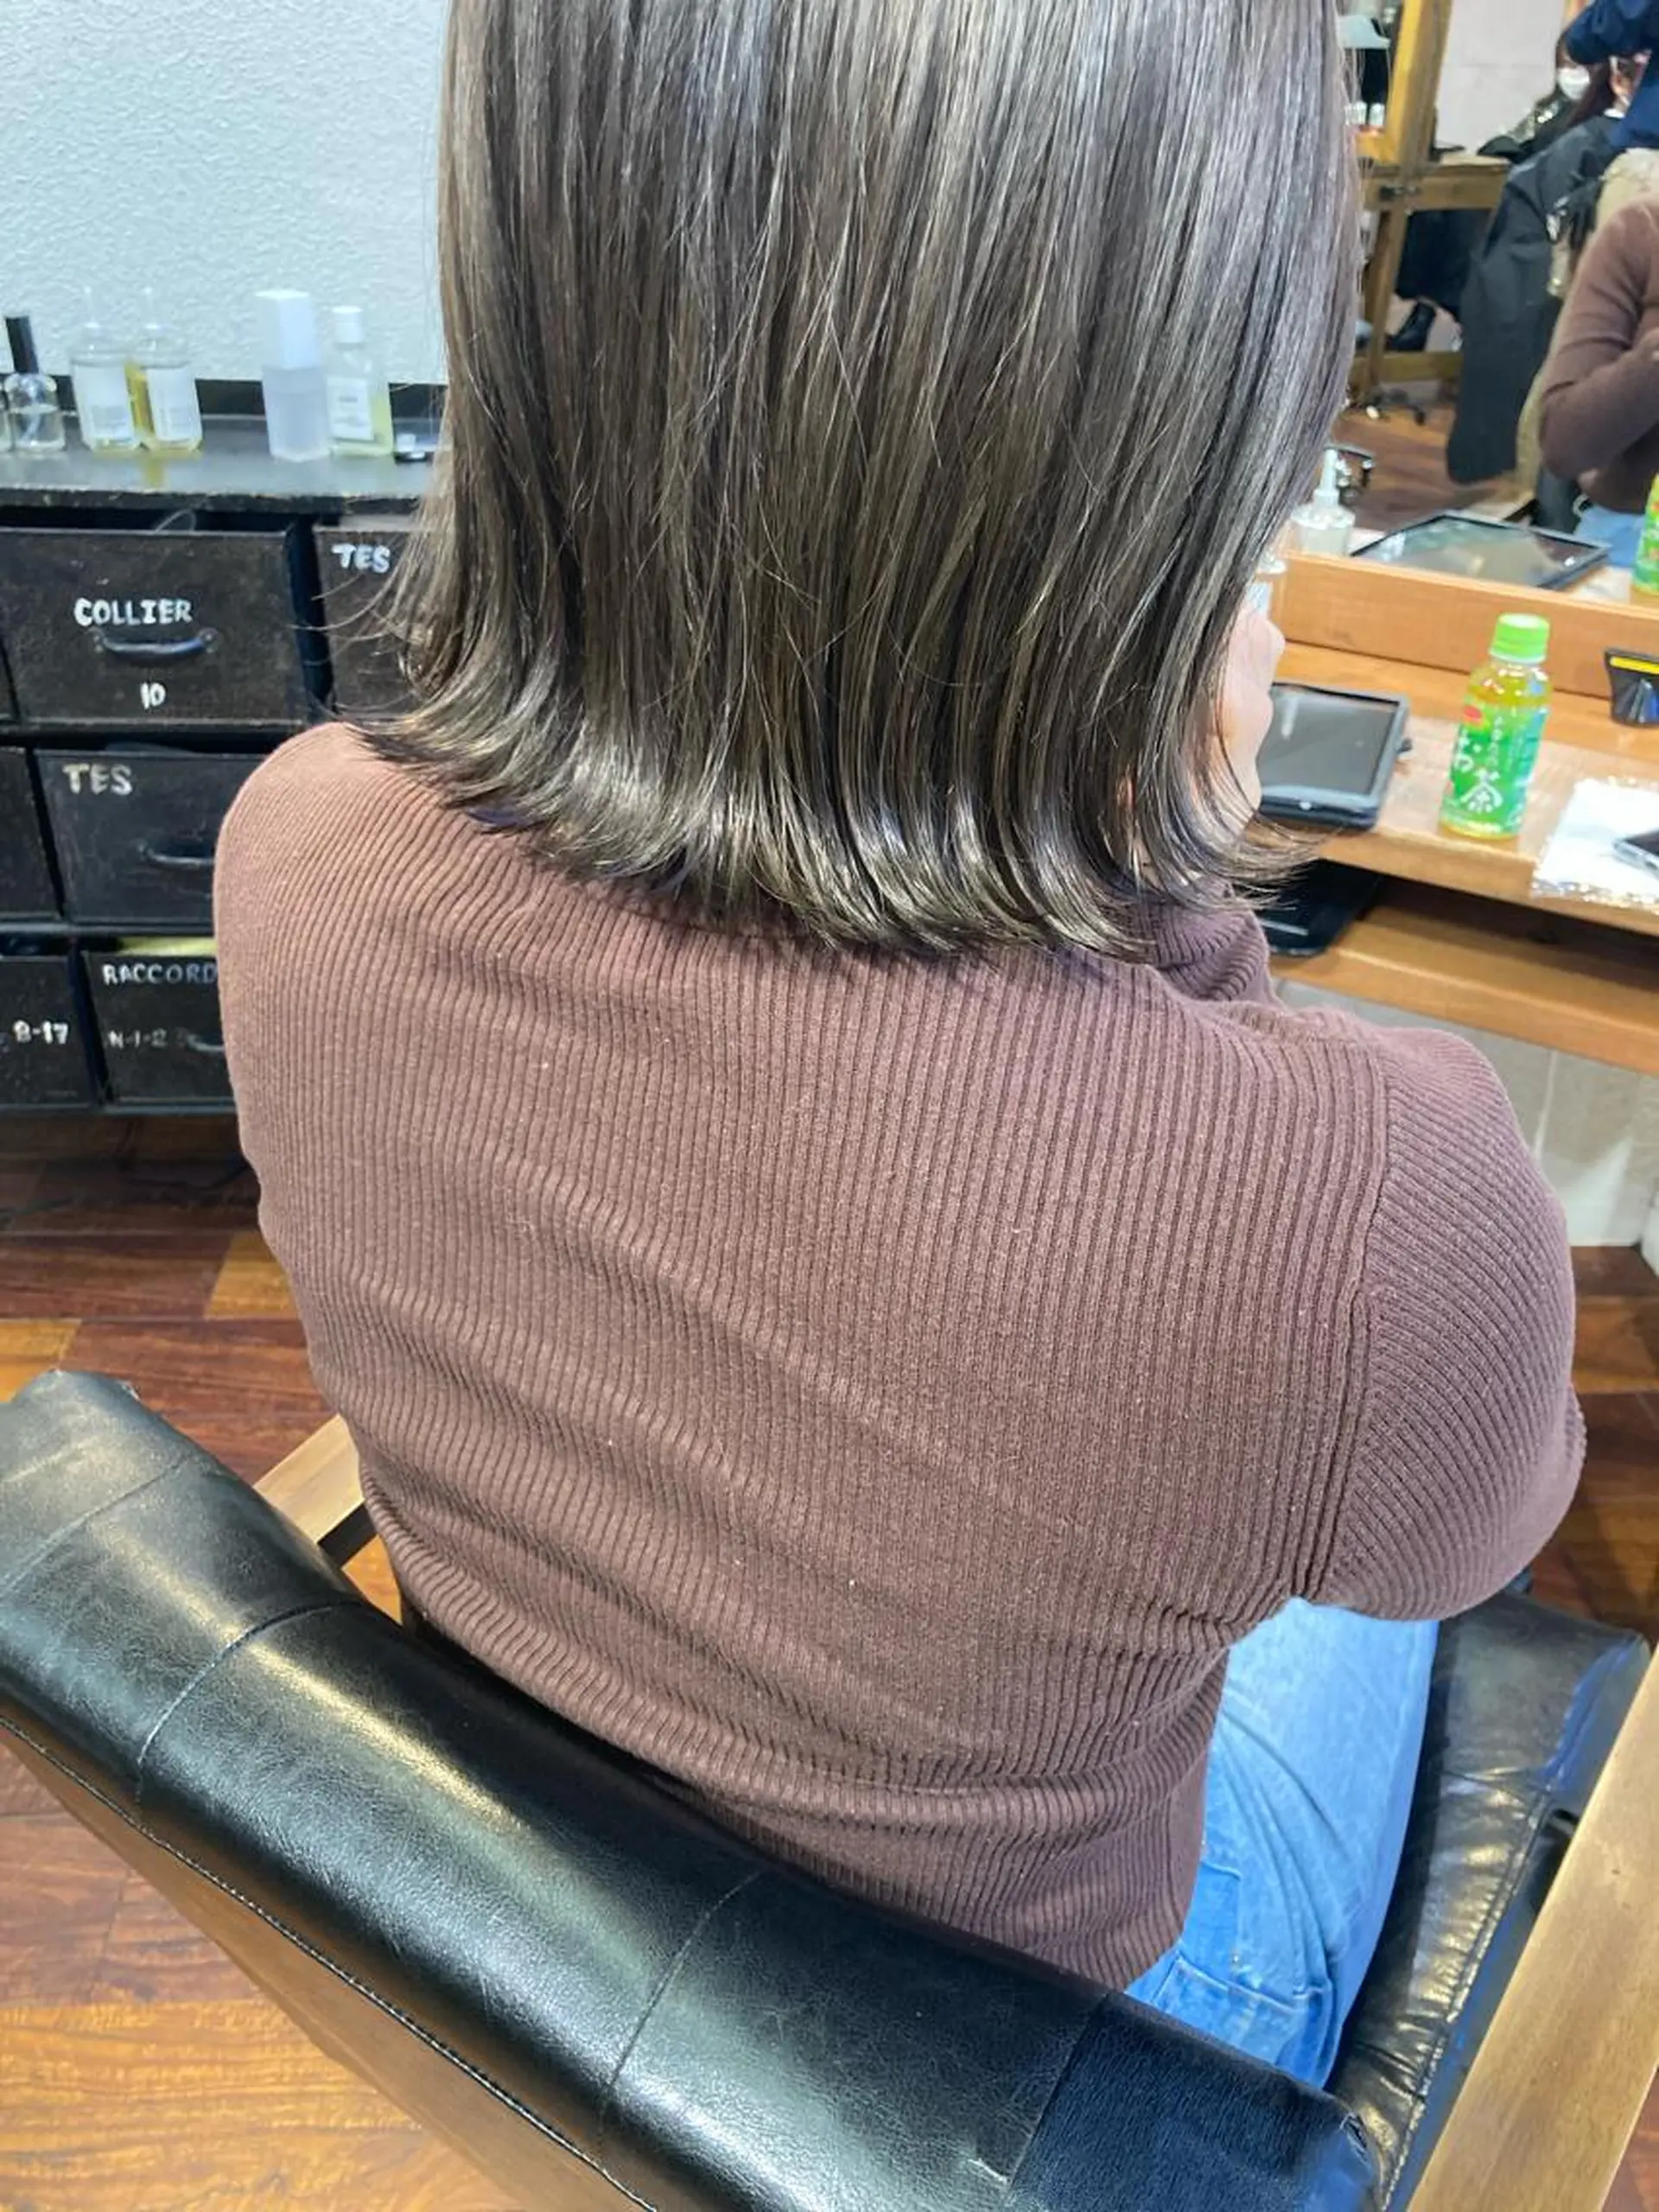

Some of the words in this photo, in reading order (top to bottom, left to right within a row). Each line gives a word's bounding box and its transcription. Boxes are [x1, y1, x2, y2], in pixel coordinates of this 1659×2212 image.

[332, 543, 391, 574] TES
[74, 597, 193, 626] COLLIER
[140, 683, 166, 709] 10
[62, 763, 133, 795] TES
[102, 963, 217, 985] RACCORD
